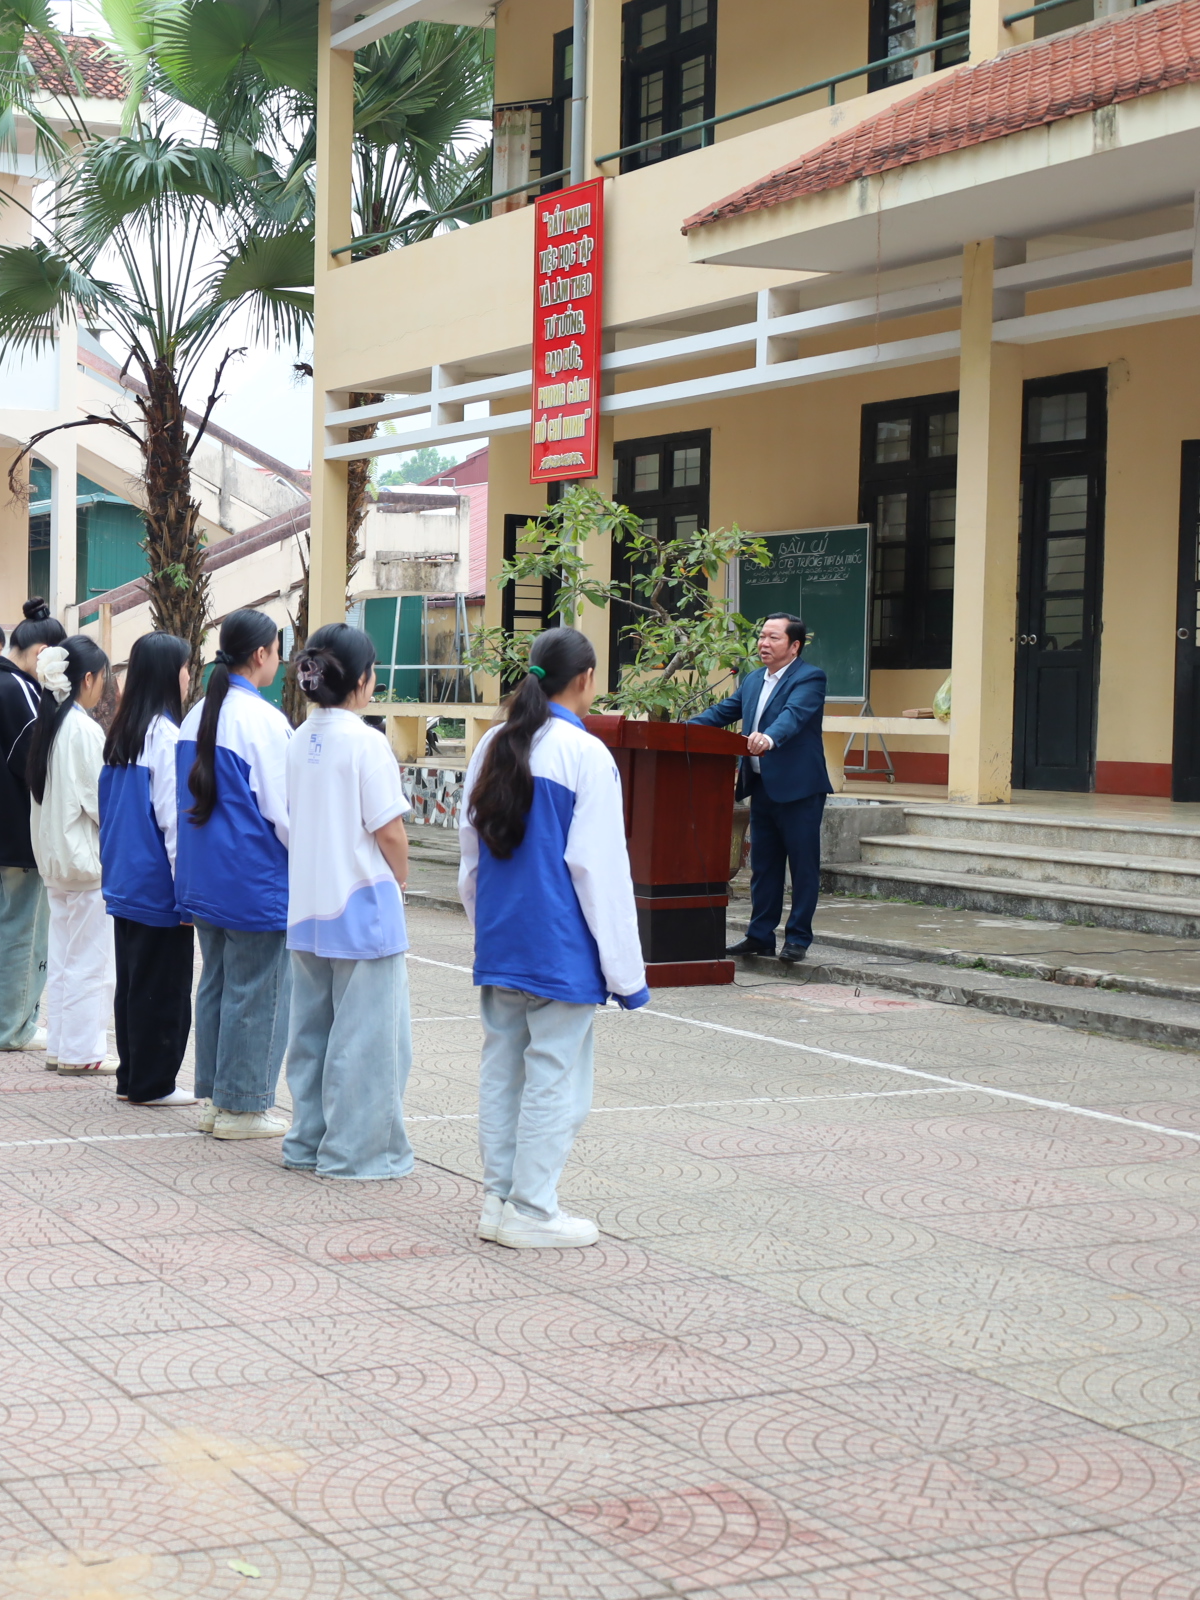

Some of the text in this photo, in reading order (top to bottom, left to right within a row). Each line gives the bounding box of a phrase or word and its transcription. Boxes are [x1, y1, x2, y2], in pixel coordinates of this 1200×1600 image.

[565, 202, 591, 234] MẠNH
[539, 234, 594, 276] VIỆC HỌC TẬP
[539, 272, 592, 307] VÀ LÀM THEO
[544, 304, 586, 340] TƯ TƯỞNG,
[545, 340, 583, 378] ĐẠO ĐỨC,
[538, 376, 591, 410] PHONG CÁCH
[535, 413, 547, 444] HỒ
[547, 413, 562, 442] CHÍ
[778, 532, 829, 554] BẦU CỬ
